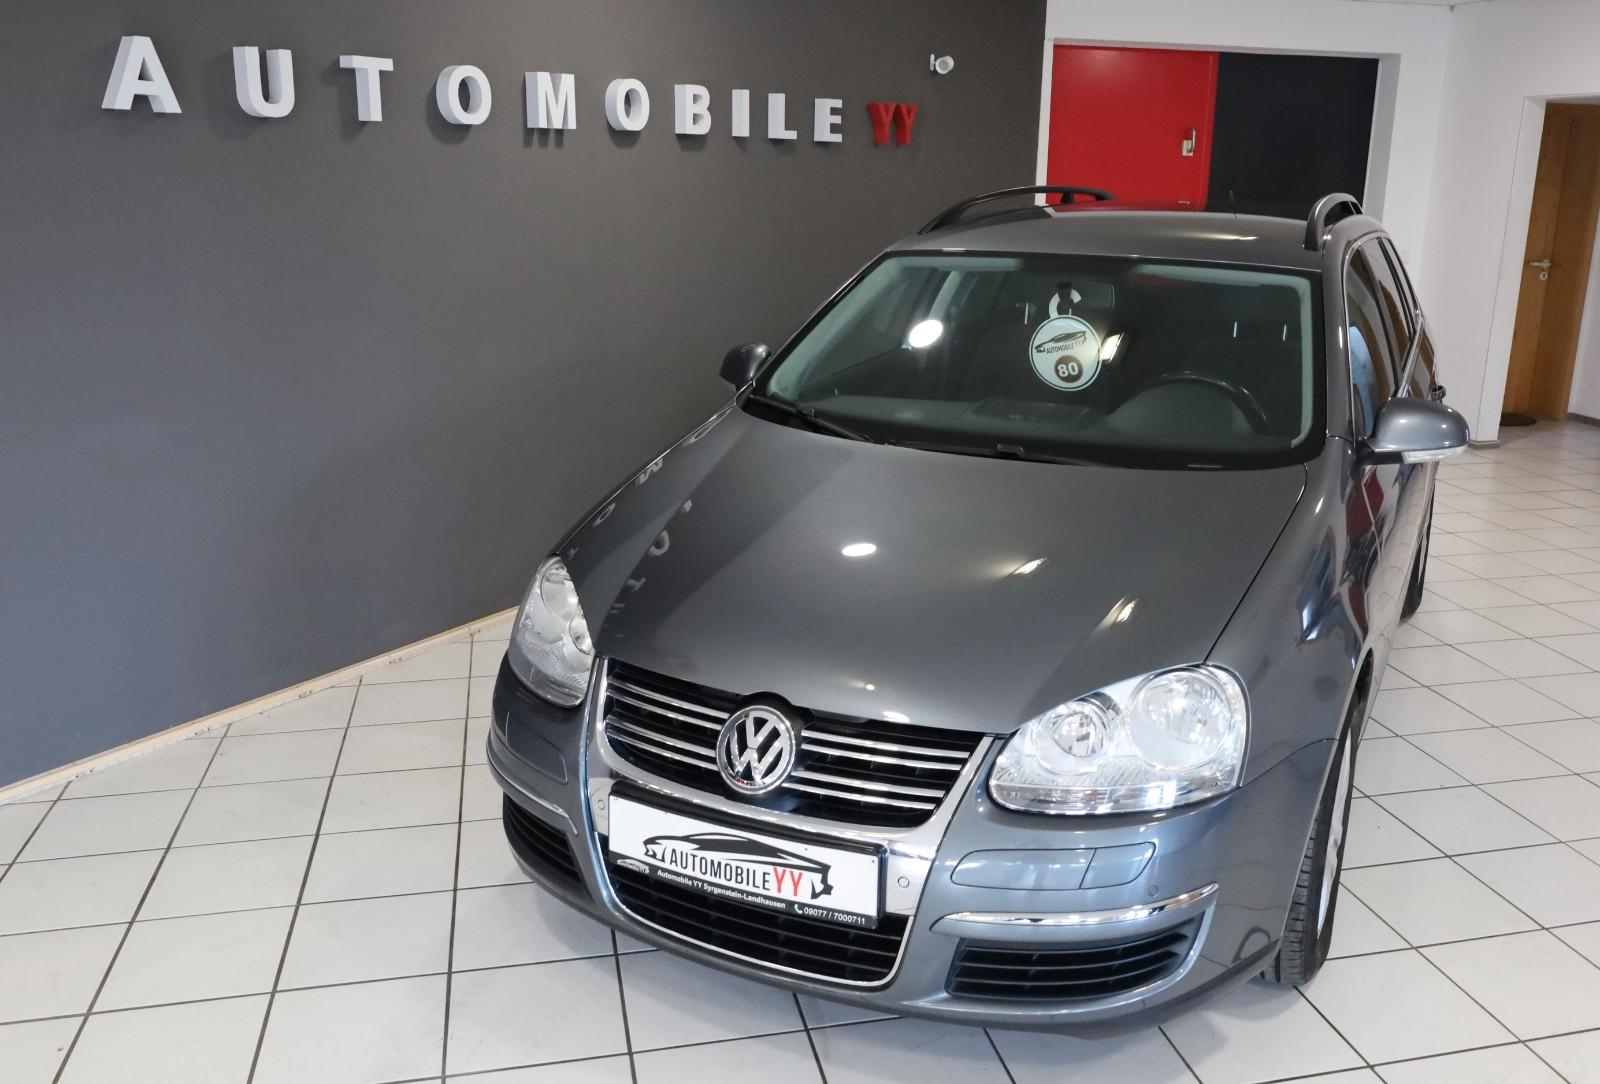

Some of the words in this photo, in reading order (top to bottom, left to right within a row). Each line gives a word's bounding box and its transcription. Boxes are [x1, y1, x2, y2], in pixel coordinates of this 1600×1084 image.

[101, 36, 843, 143] AUTOMOBILE
[866, 102, 919, 145] YY
[1058, 362, 1078, 377] 80
[717, 705, 796, 795] VW
[657, 870, 692, 886] Automobile
[693, 879, 703, 888] YY
[833, 912, 865, 925] 7000711
